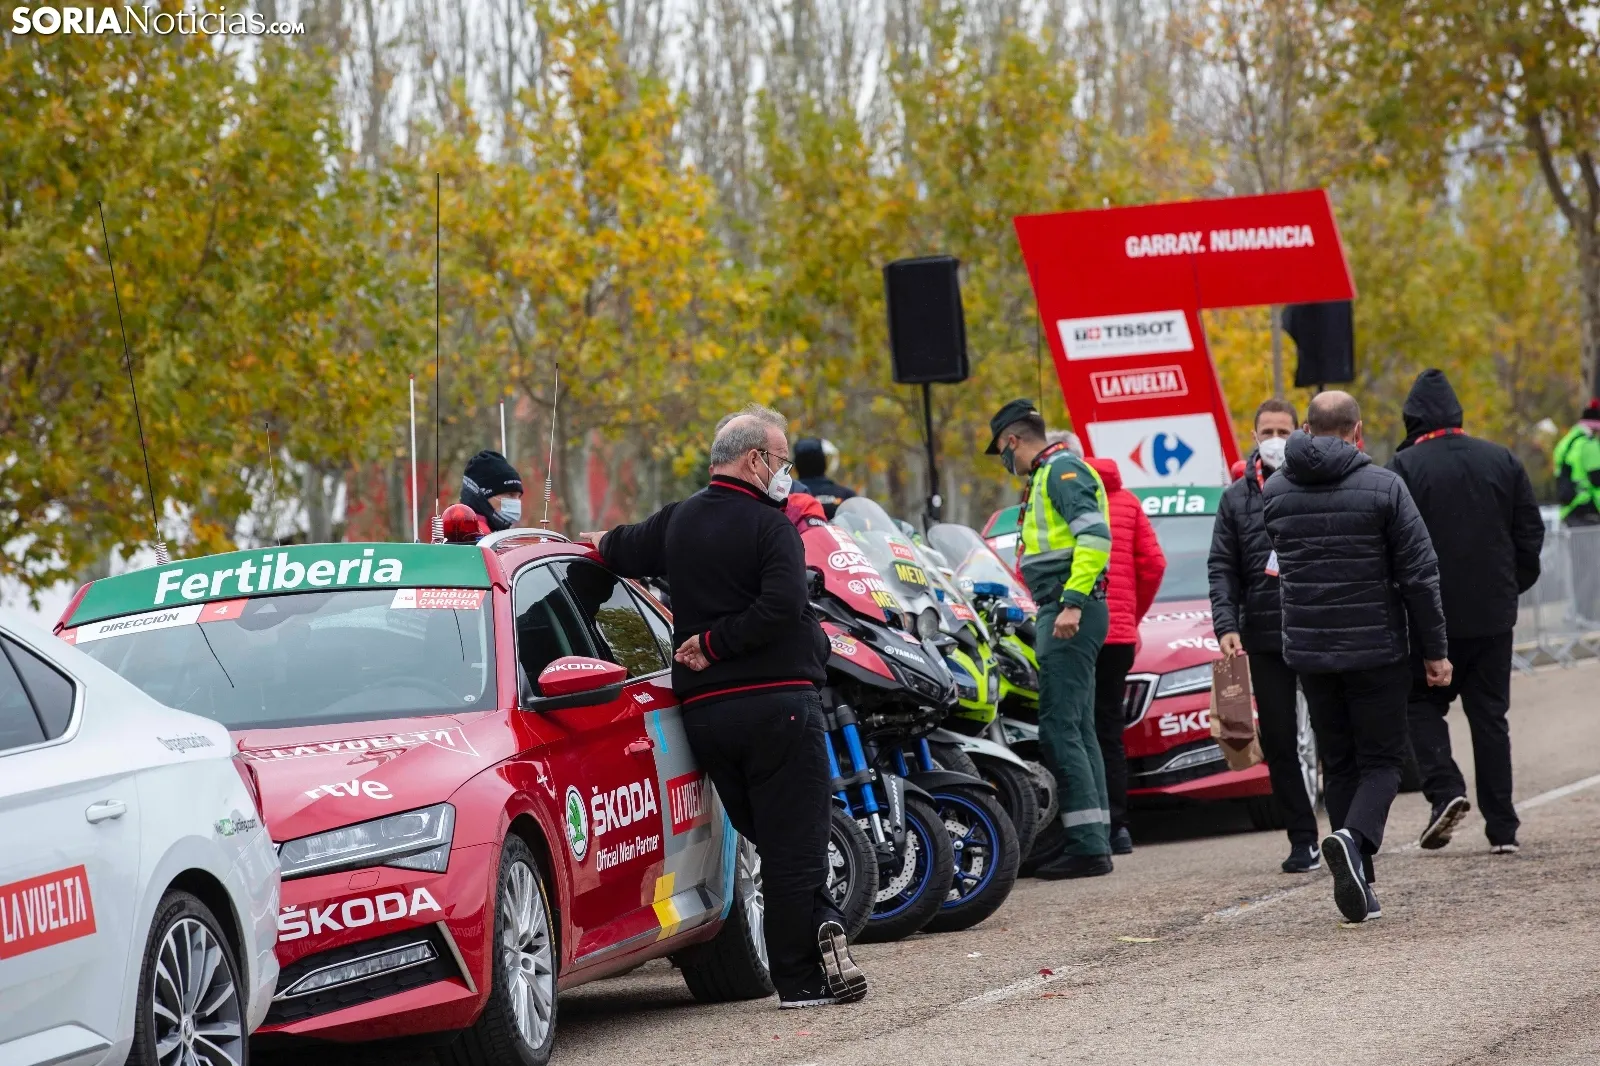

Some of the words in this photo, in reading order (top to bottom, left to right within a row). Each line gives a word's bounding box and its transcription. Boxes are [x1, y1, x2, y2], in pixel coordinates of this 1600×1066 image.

[1125, 231, 1206, 258] GARRAY.
[1210, 224, 1315, 252] NUMANCIA
[1104, 320, 1175, 338] TISSOT
[1100, 376, 1122, 398] LA
[1120, 371, 1178, 395] VUELTA
[153, 548, 403, 605] Fertiberia
[895, 563, 928, 586] META
[419, 598, 477, 607] CARRERA
[422, 591, 480, 599] BURBUJA
[98, 612, 180, 634] DIRECCIÓN
[214, 605, 228, 615] 4
[894, 648, 925, 664] YAMAHA
[1159, 709, 1211, 737] ŠKO
[270, 744, 317, 759] LA
[323, 730, 455, 752] VUELTA
[304, 779, 393, 800] rtve
[590, 777, 658, 837] ŠKODA
[671, 788, 684, 825] LA
[596, 843, 619, 872] Official
[620, 839, 636, 864] Main
[636, 834, 660, 857] Partner
[0, 896, 25, 944] LA
[22, 876, 87, 936] VUELTA
[278, 887, 442, 942] ŠKODA
